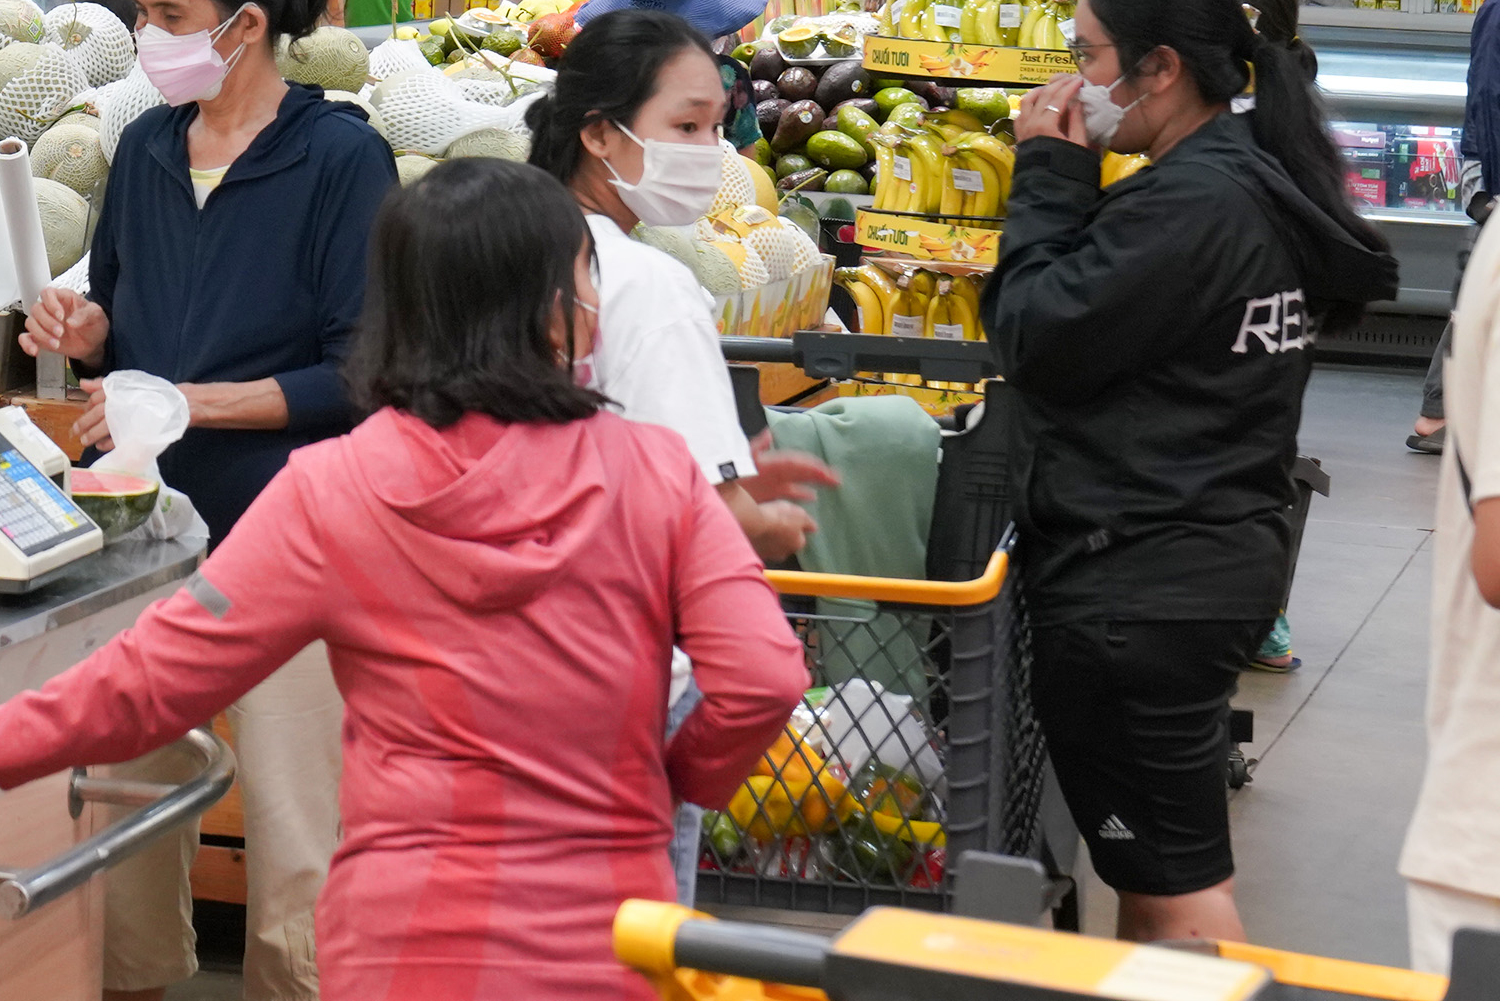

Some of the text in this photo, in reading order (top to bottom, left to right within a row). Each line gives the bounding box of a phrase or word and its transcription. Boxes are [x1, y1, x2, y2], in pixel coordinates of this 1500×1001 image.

[872, 47, 909, 67] CHUỐI TƯƠI
[1019, 52, 1040, 63] Just
[1230, 288, 1317, 354] RE
